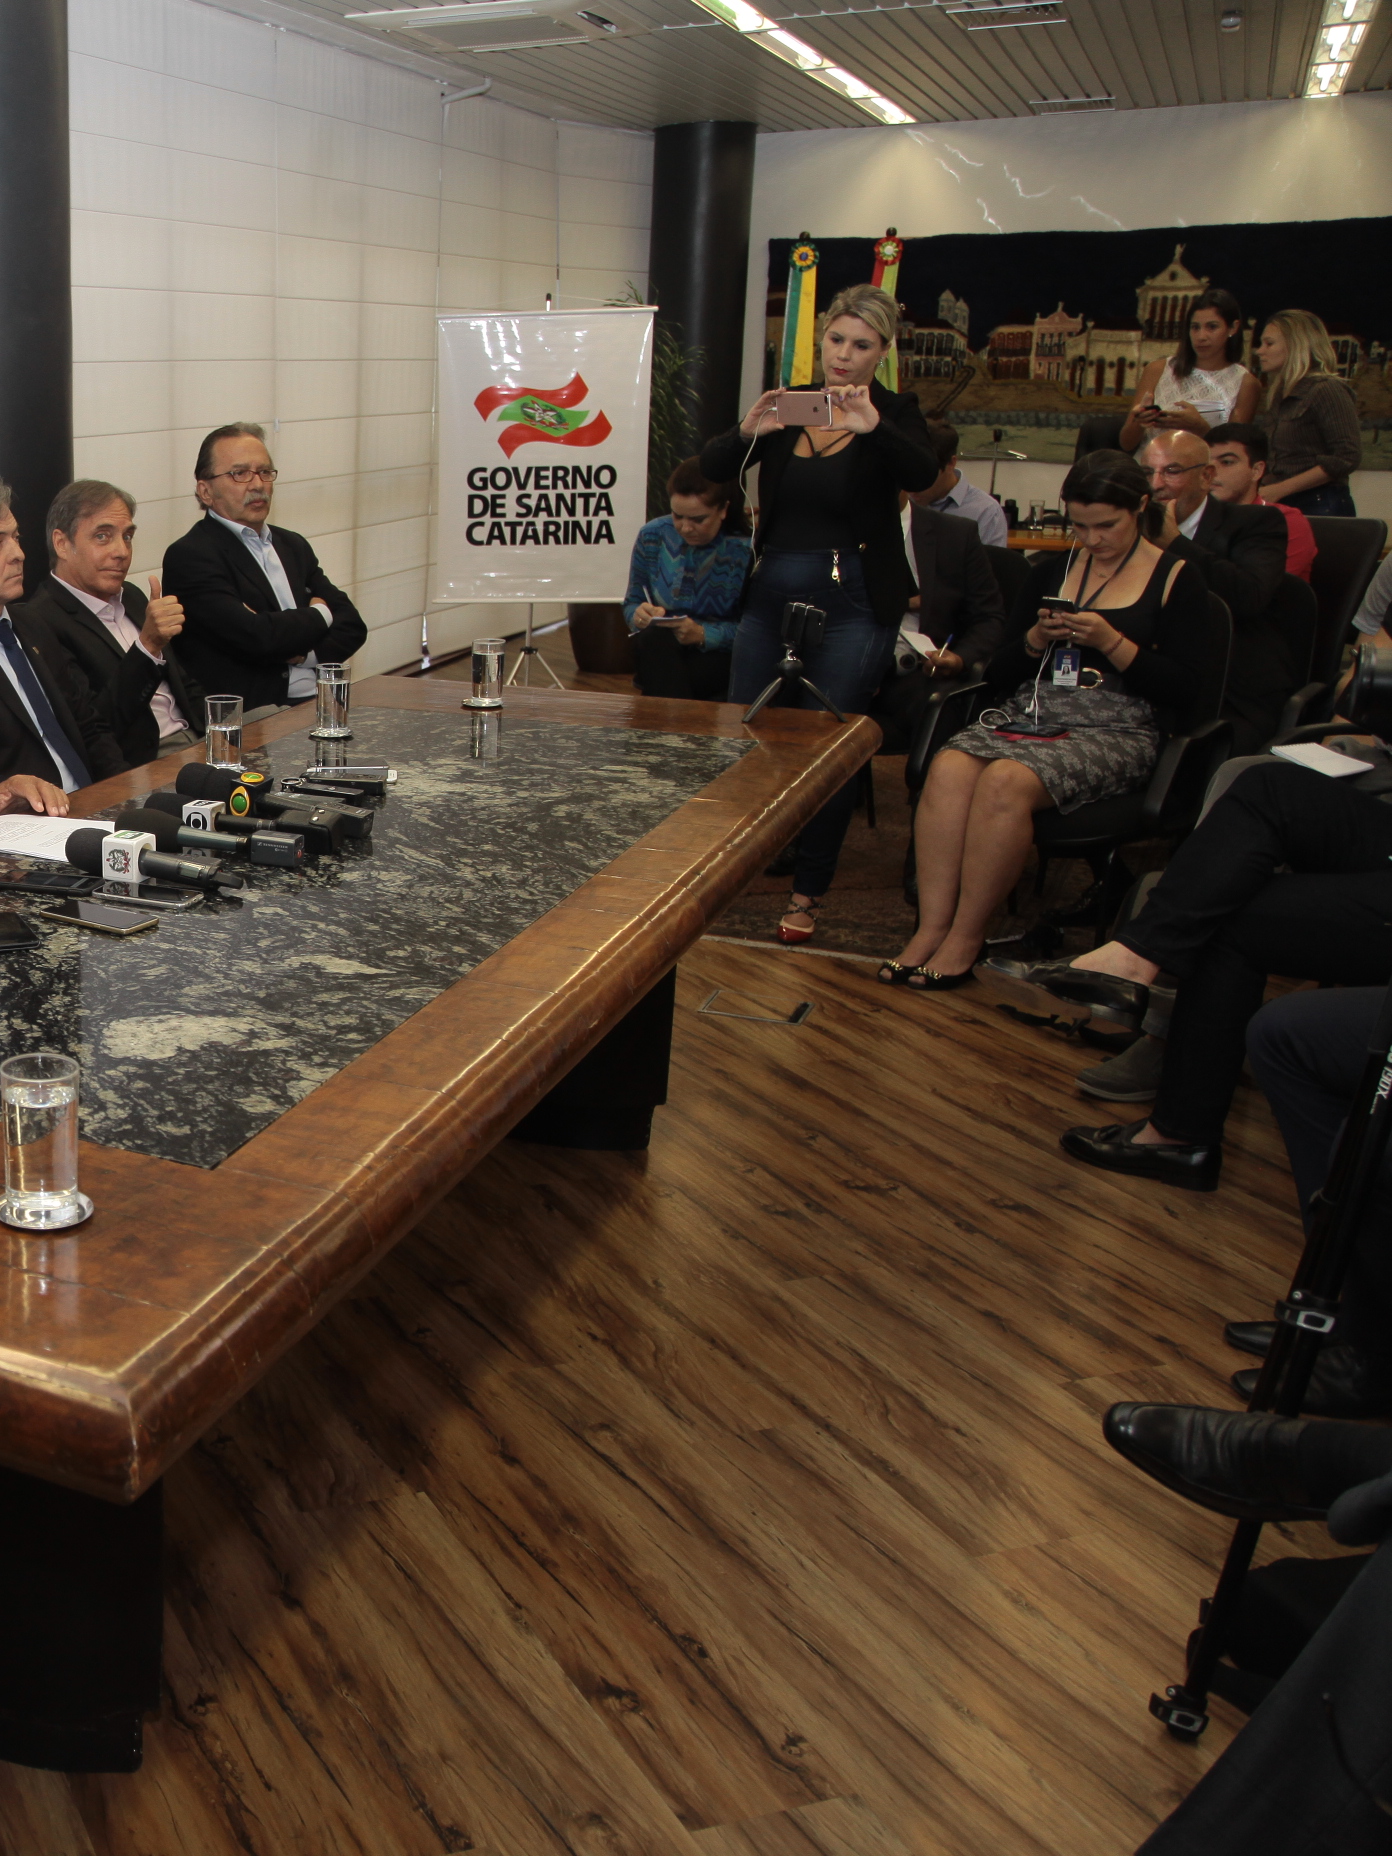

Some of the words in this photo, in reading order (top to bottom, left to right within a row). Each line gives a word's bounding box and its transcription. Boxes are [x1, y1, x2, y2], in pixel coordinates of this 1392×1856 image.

[467, 464, 617, 491] GOVERNO
[467, 494, 506, 519] DE
[515, 492, 615, 519] SANTA
[465, 520, 615, 546] CATARINA
